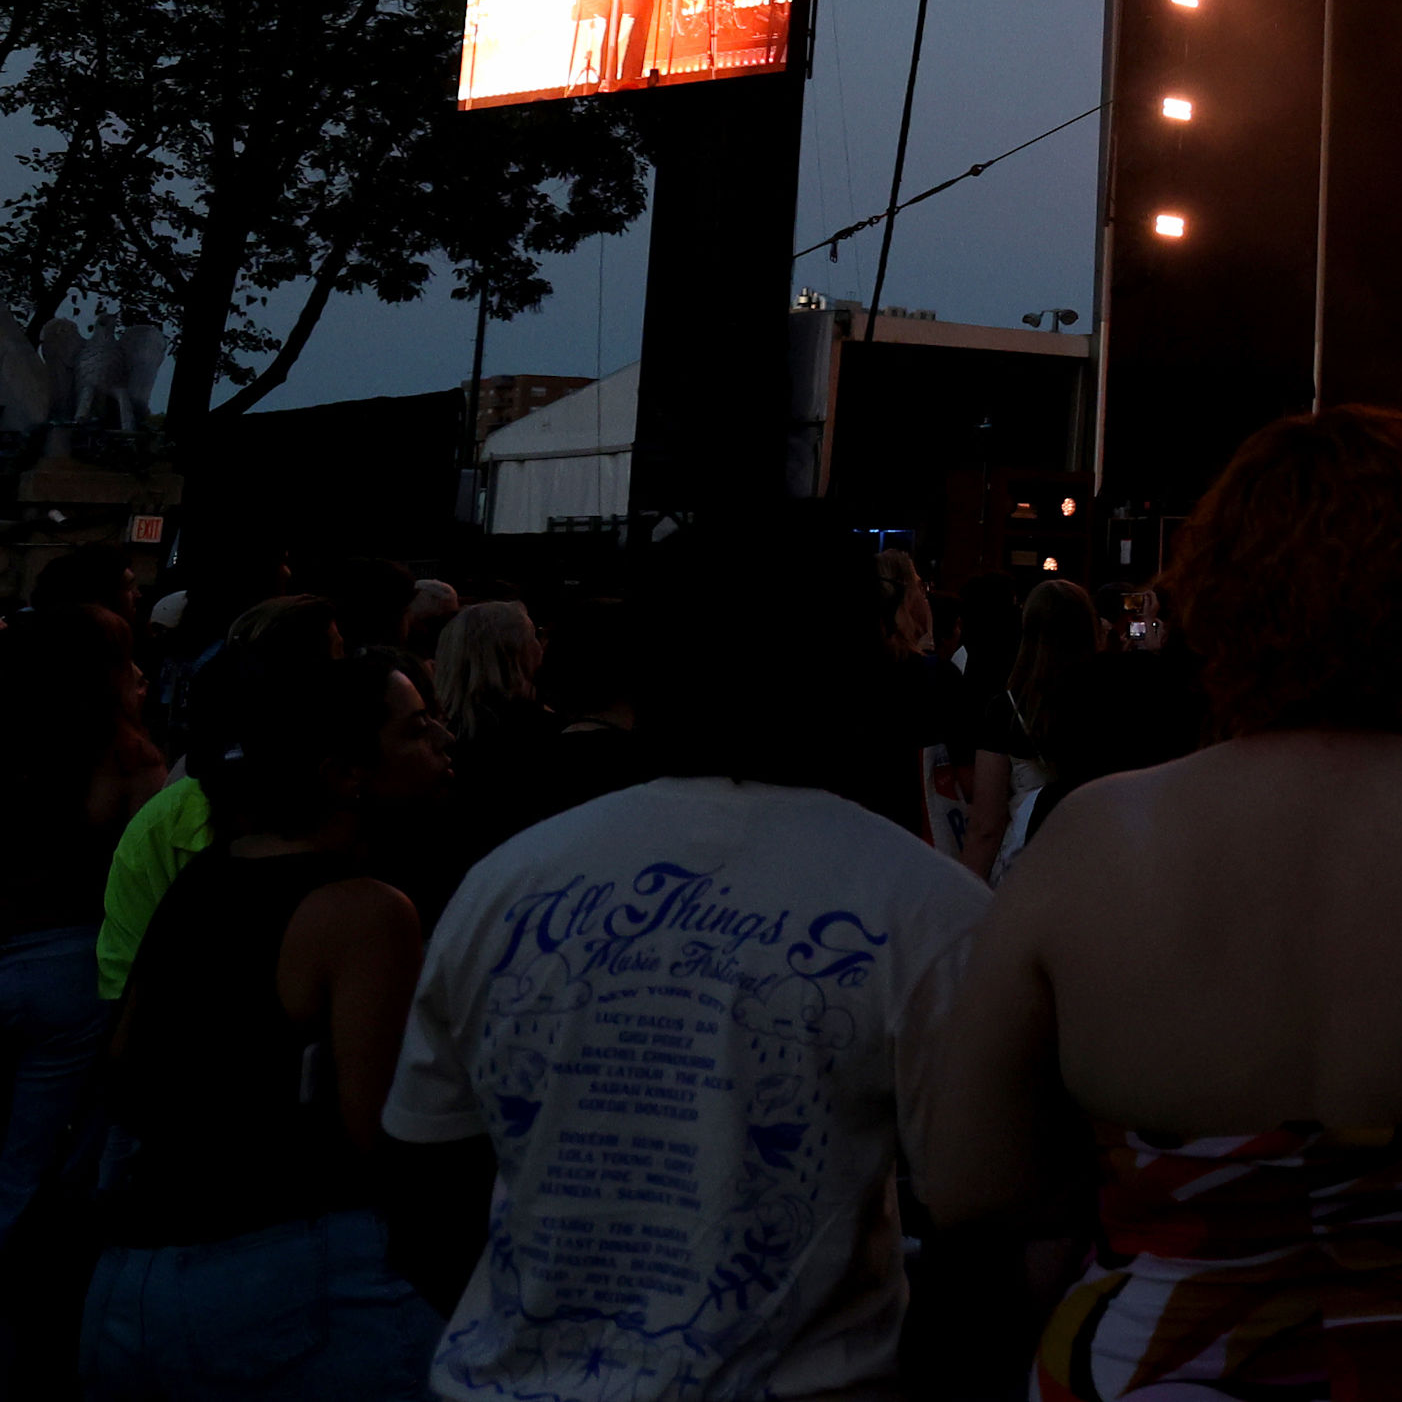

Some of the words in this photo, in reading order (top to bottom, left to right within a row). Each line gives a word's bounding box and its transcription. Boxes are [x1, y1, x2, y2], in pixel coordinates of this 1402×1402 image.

[136, 518, 161, 539] EXIT
[491, 875, 617, 976] All
[604, 862, 789, 951] Things
[582, 935, 661, 976] Music
